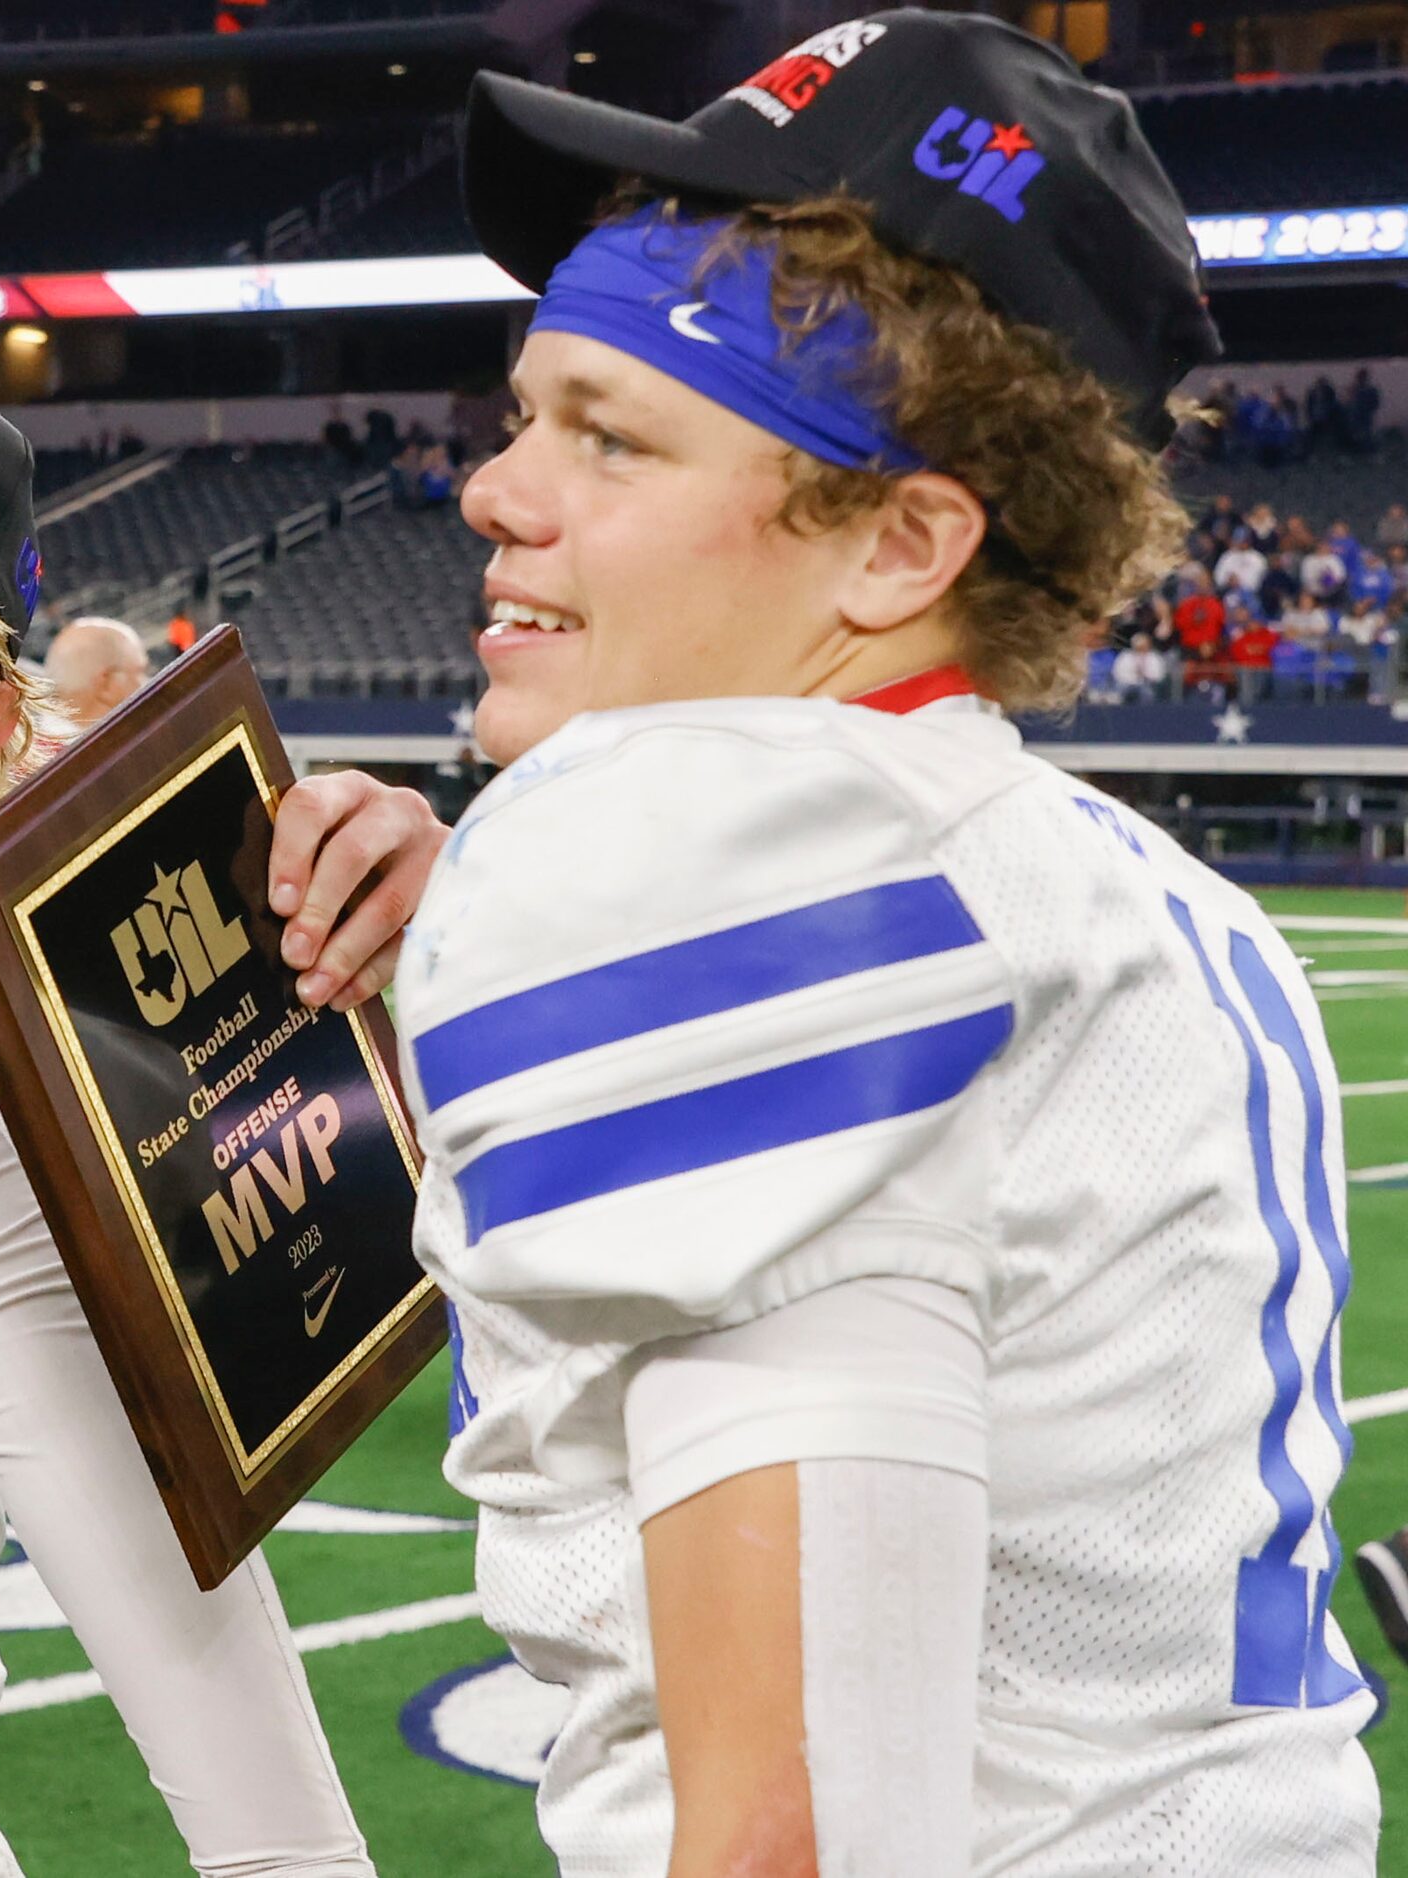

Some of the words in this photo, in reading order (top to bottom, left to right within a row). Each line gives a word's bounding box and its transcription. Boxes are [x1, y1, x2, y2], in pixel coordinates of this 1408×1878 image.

[1274, 209, 1407, 256] 2023
[180, 991, 260, 1077] Football
[137, 1114, 189, 1169] State
[212, 1075, 304, 1171] OFFENSE
[200, 1092, 342, 1277] MVP
[287, 1223, 323, 1270] 2023
